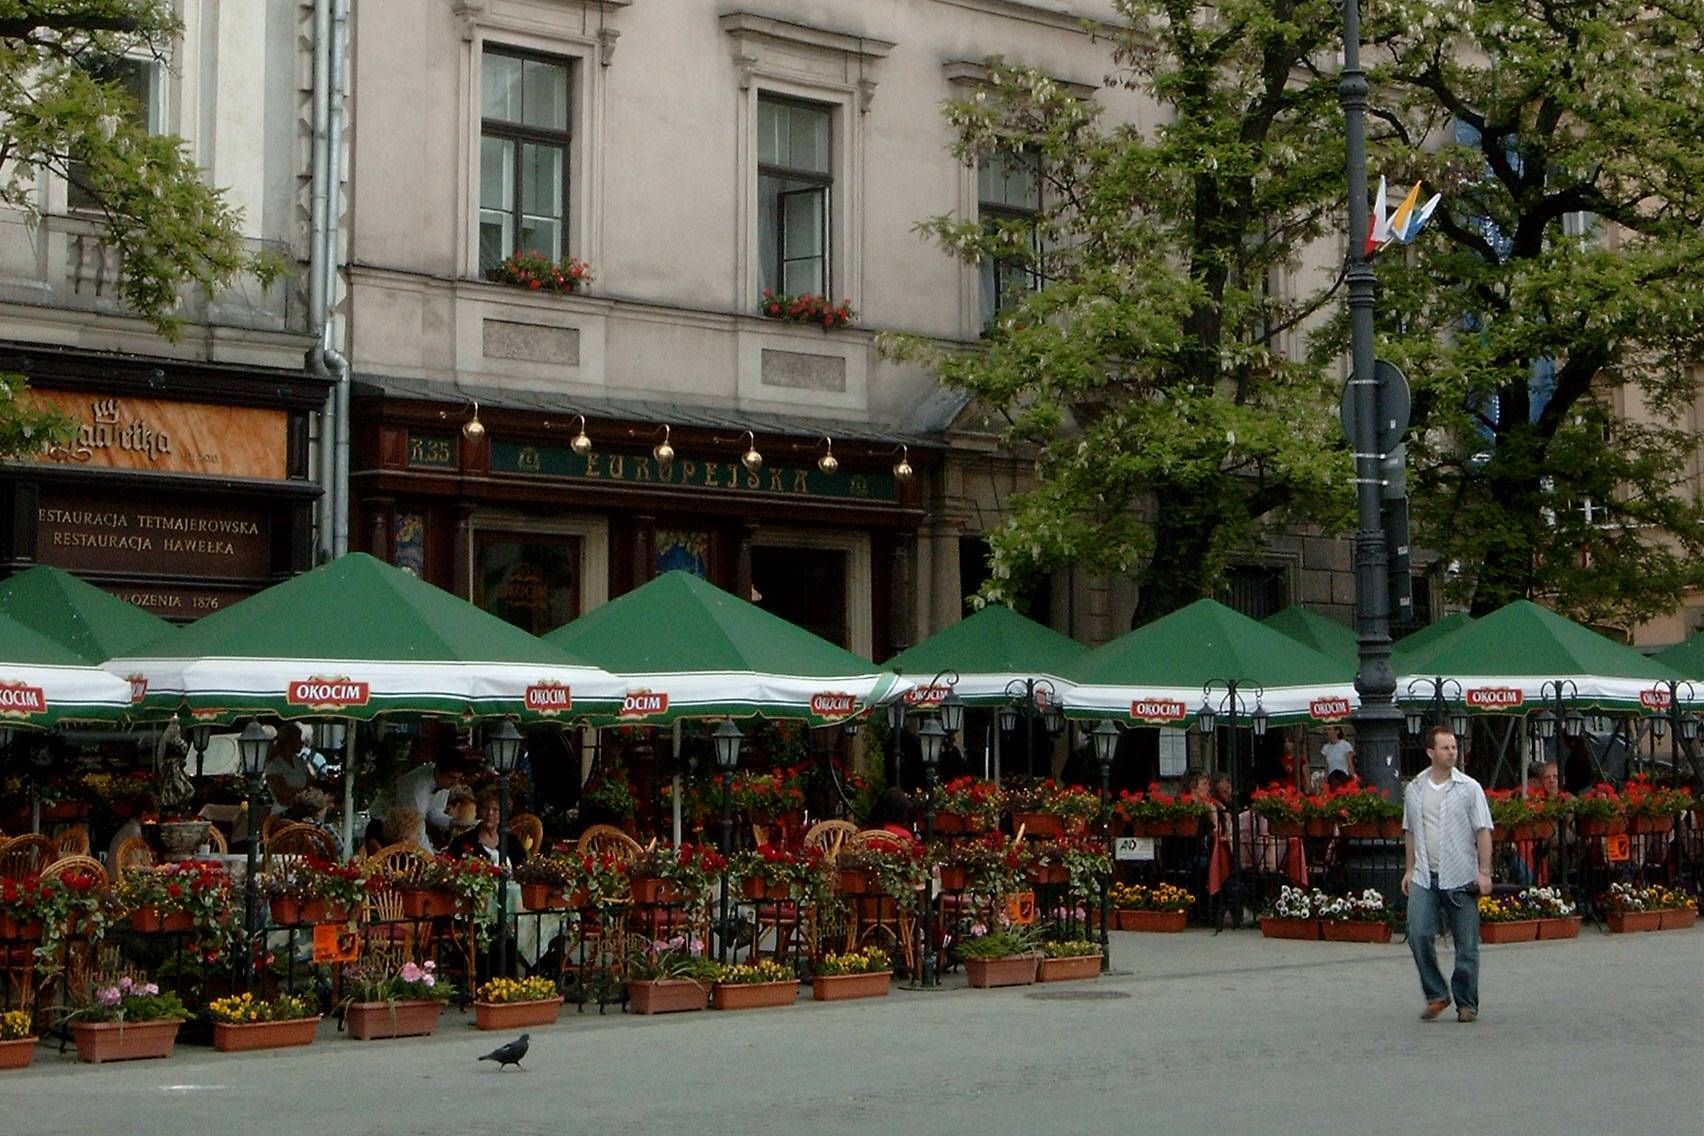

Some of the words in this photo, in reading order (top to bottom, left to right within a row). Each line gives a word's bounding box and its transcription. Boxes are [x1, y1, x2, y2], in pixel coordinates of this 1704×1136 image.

[38, 509, 127, 527] ESTAURACJA
[138, 515, 258, 535] TETMAJEROWSKA
[54, 532, 151, 551] RESTAURACJA
[192, 596, 218, 609] 1876
[0, 690, 38, 706] OCIM
[296, 684, 360, 700] OKOCIM
[530, 689, 567, 704] OKOCIM
[1472, 691, 1517, 702] OKOCIM
[622, 696, 661, 711] OCIM
[1136, 703, 1180, 715] OKOCIM
